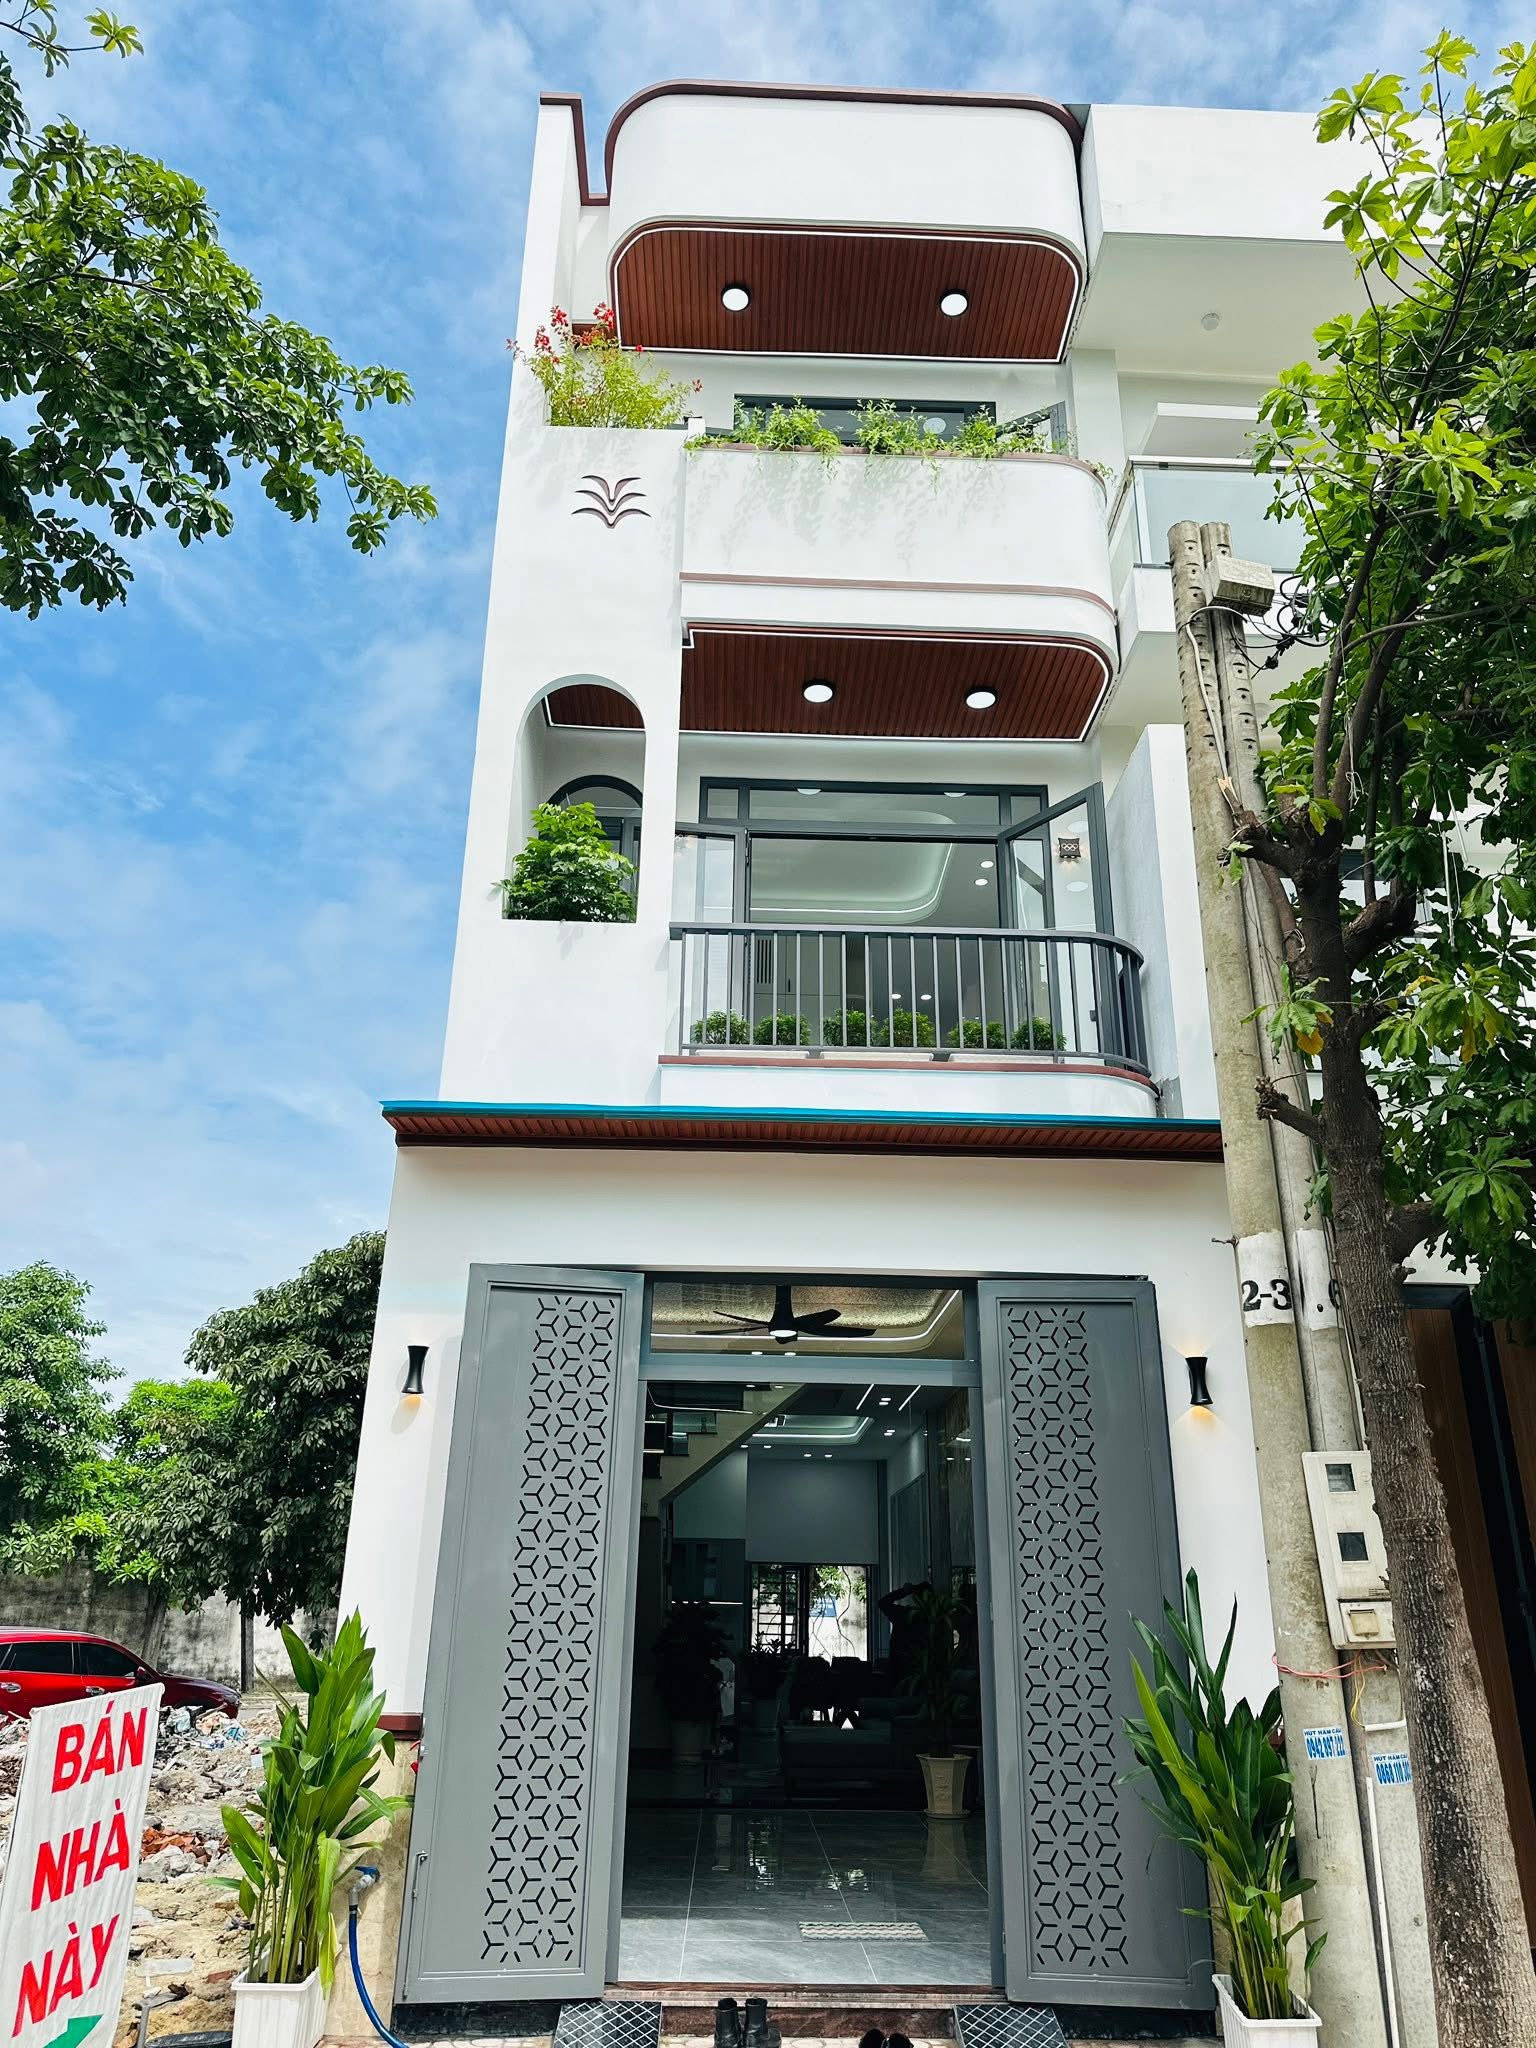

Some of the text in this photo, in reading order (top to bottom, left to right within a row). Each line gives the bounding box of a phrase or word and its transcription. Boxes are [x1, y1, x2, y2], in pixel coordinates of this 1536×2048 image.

[1241, 1278, 1293, 1312] 2-3
[51, 1701, 148, 1793] BÁN
[31, 1799, 130, 1912] NHÀ
[12, 1913, 120, 2038] NÀY
